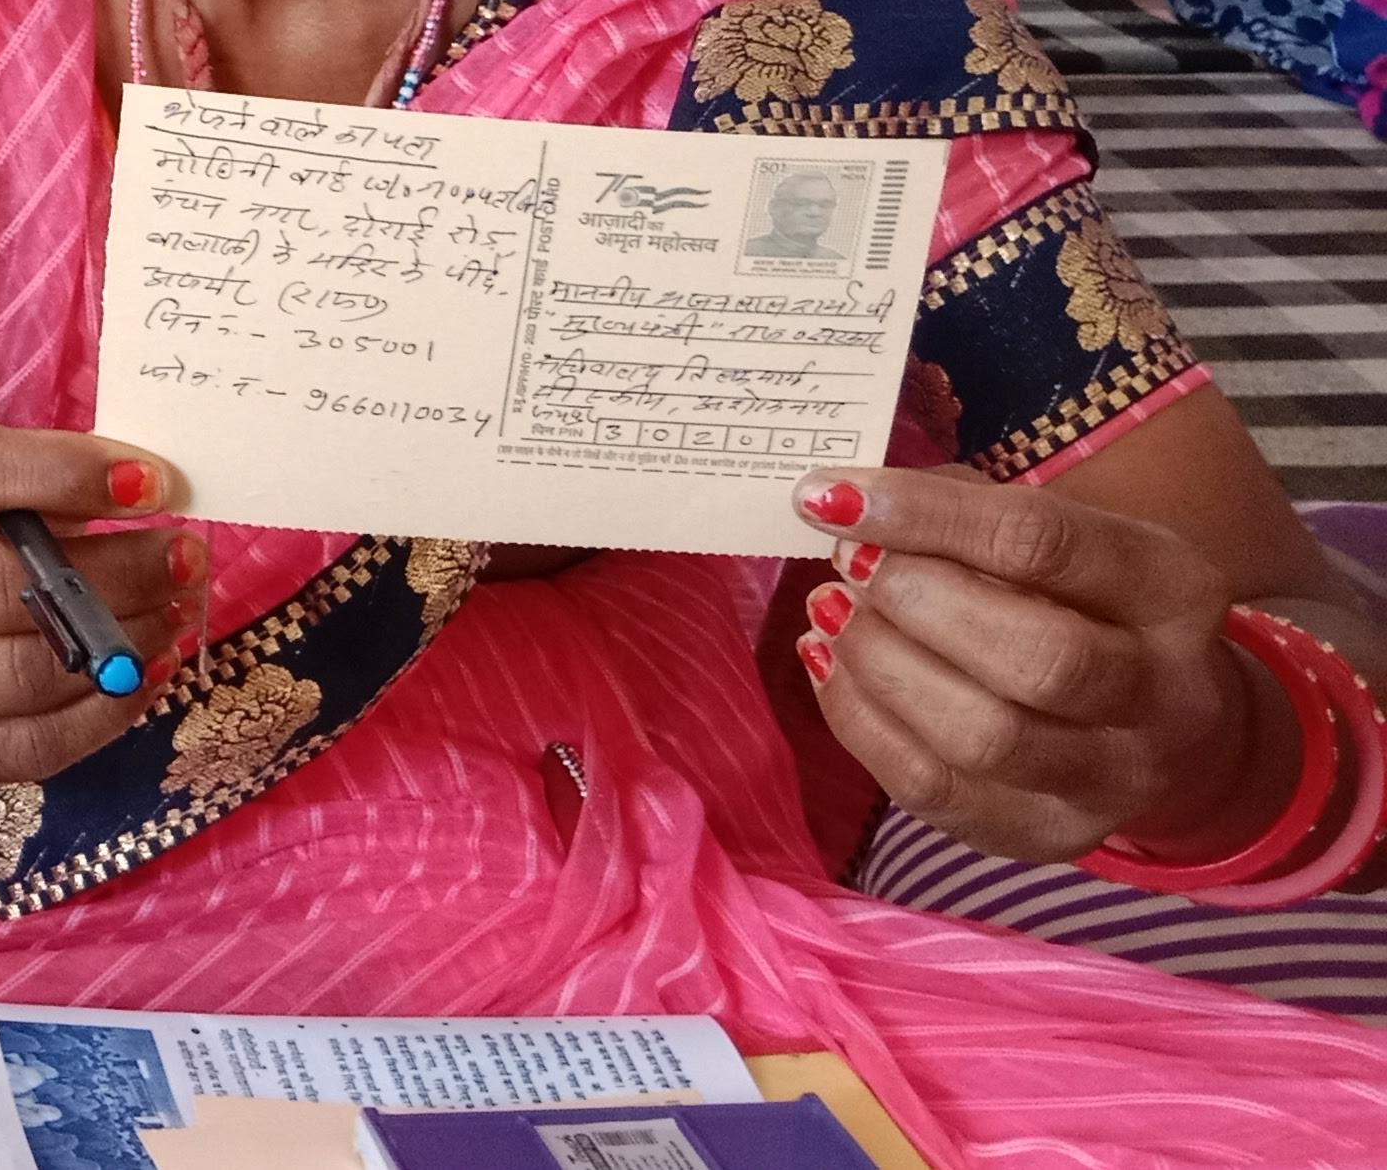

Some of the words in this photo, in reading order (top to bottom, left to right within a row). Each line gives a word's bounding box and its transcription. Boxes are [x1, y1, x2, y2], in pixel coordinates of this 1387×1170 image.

[537, 217, 555, 253] POST
[595, 232, 642, 254] अमृत
[648, 231, 720, 253] महोत्सव
[294, 329, 435, 362] 305001
[304, 389, 492, 437] 9660110034
[558, 426, 584, 438] PIN
